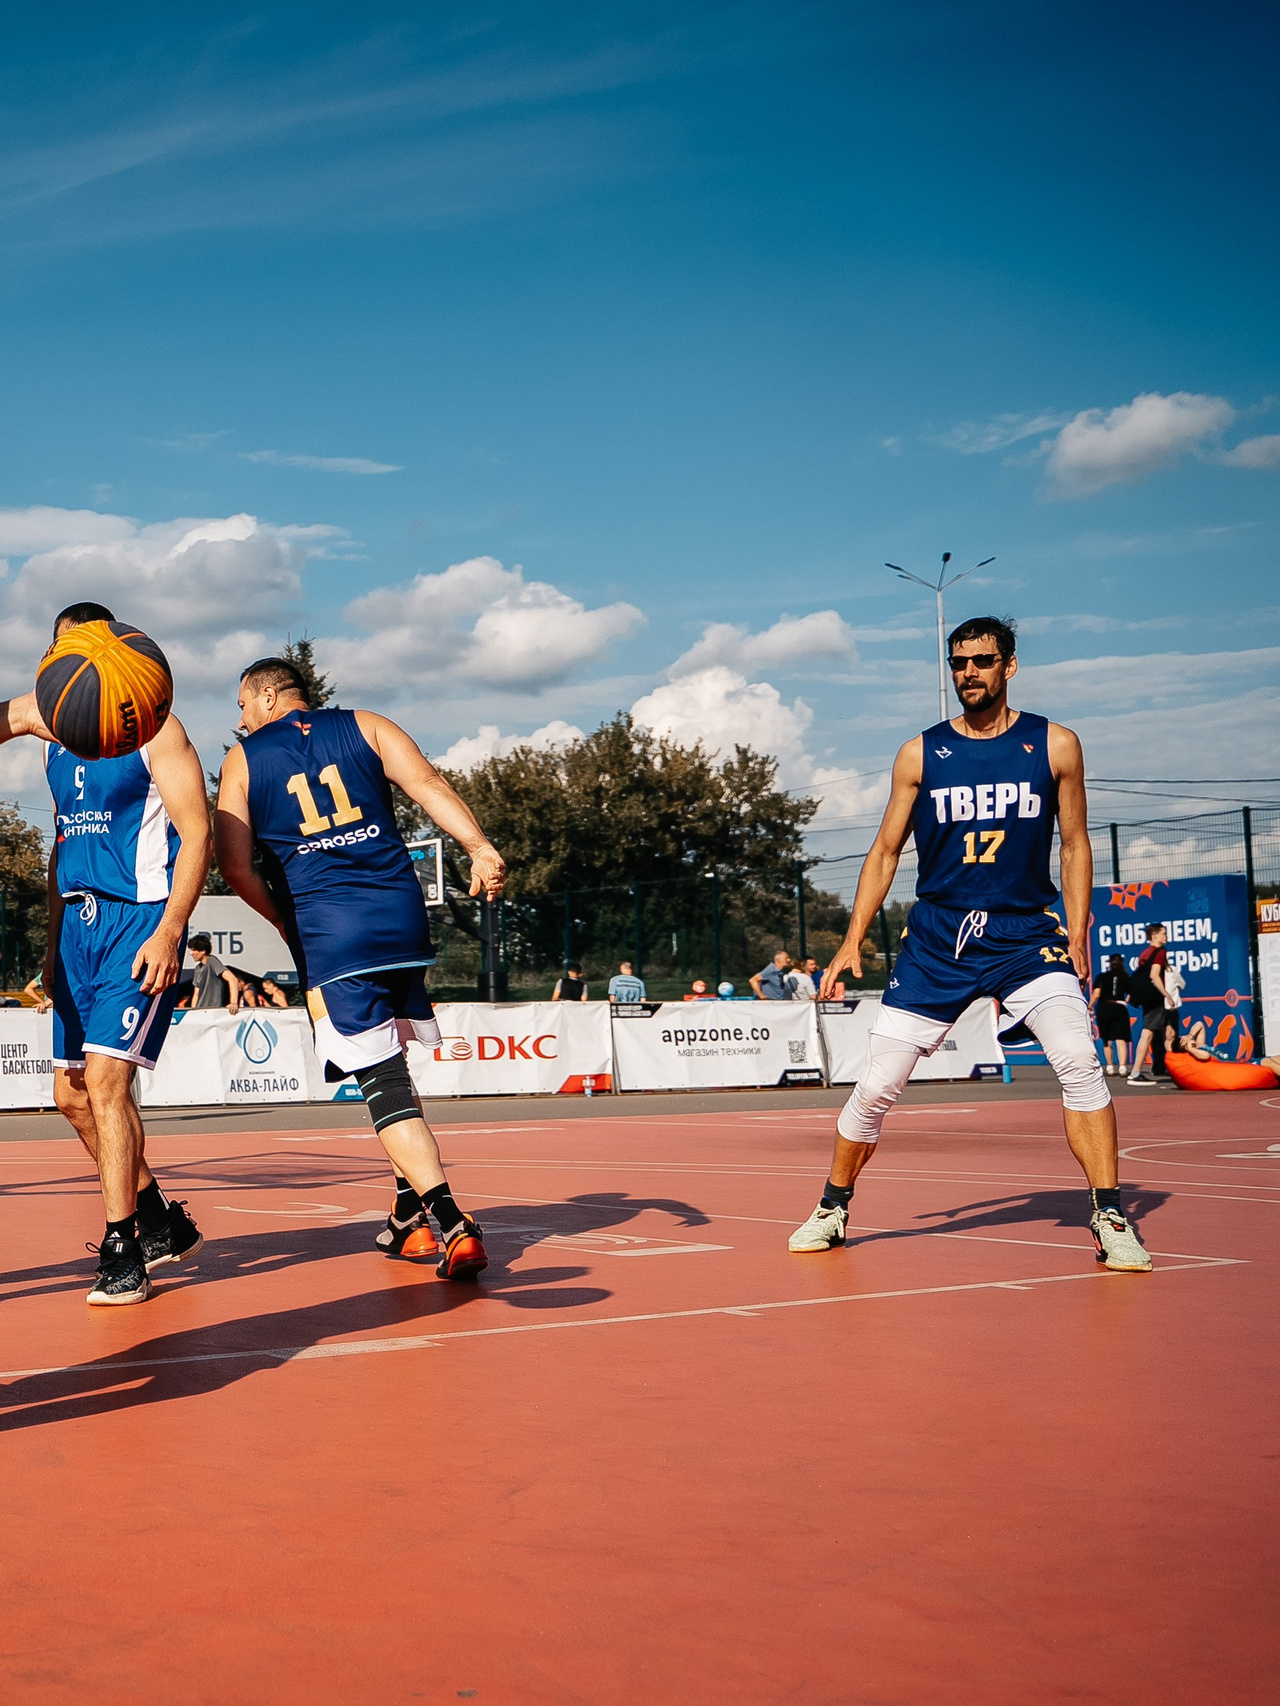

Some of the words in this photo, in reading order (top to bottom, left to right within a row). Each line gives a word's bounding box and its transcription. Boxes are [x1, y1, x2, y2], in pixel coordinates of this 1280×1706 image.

[287, 764, 363, 836] 11
[930, 782, 1041, 824] ТВЕРЬ
[297, 825, 380, 855] OPROSSO
[963, 830, 1005, 864] 17
[1261, 903, 1280, 922] КУБ
[1099, 925, 1112, 947] С
[1116, 918, 1218, 944] ЮБЛЕЕМ,
[1129, 948, 1219, 972] «ЕРЬ»!
[120, 1006, 140, 1040] 9
[477, 1034, 558, 1061] DKC
[662, 1027, 770, 1046] appzone.co
[1, 1044, 28, 1061] ЦЕНТР
[678, 1048, 719, 1057] магазин
[720, 1046, 762, 1056] техники
[3, 1058, 54, 1076] БАСКЕТБОЛ
[230, 1075, 299, 1094] АКВА-ЛАЙФ
